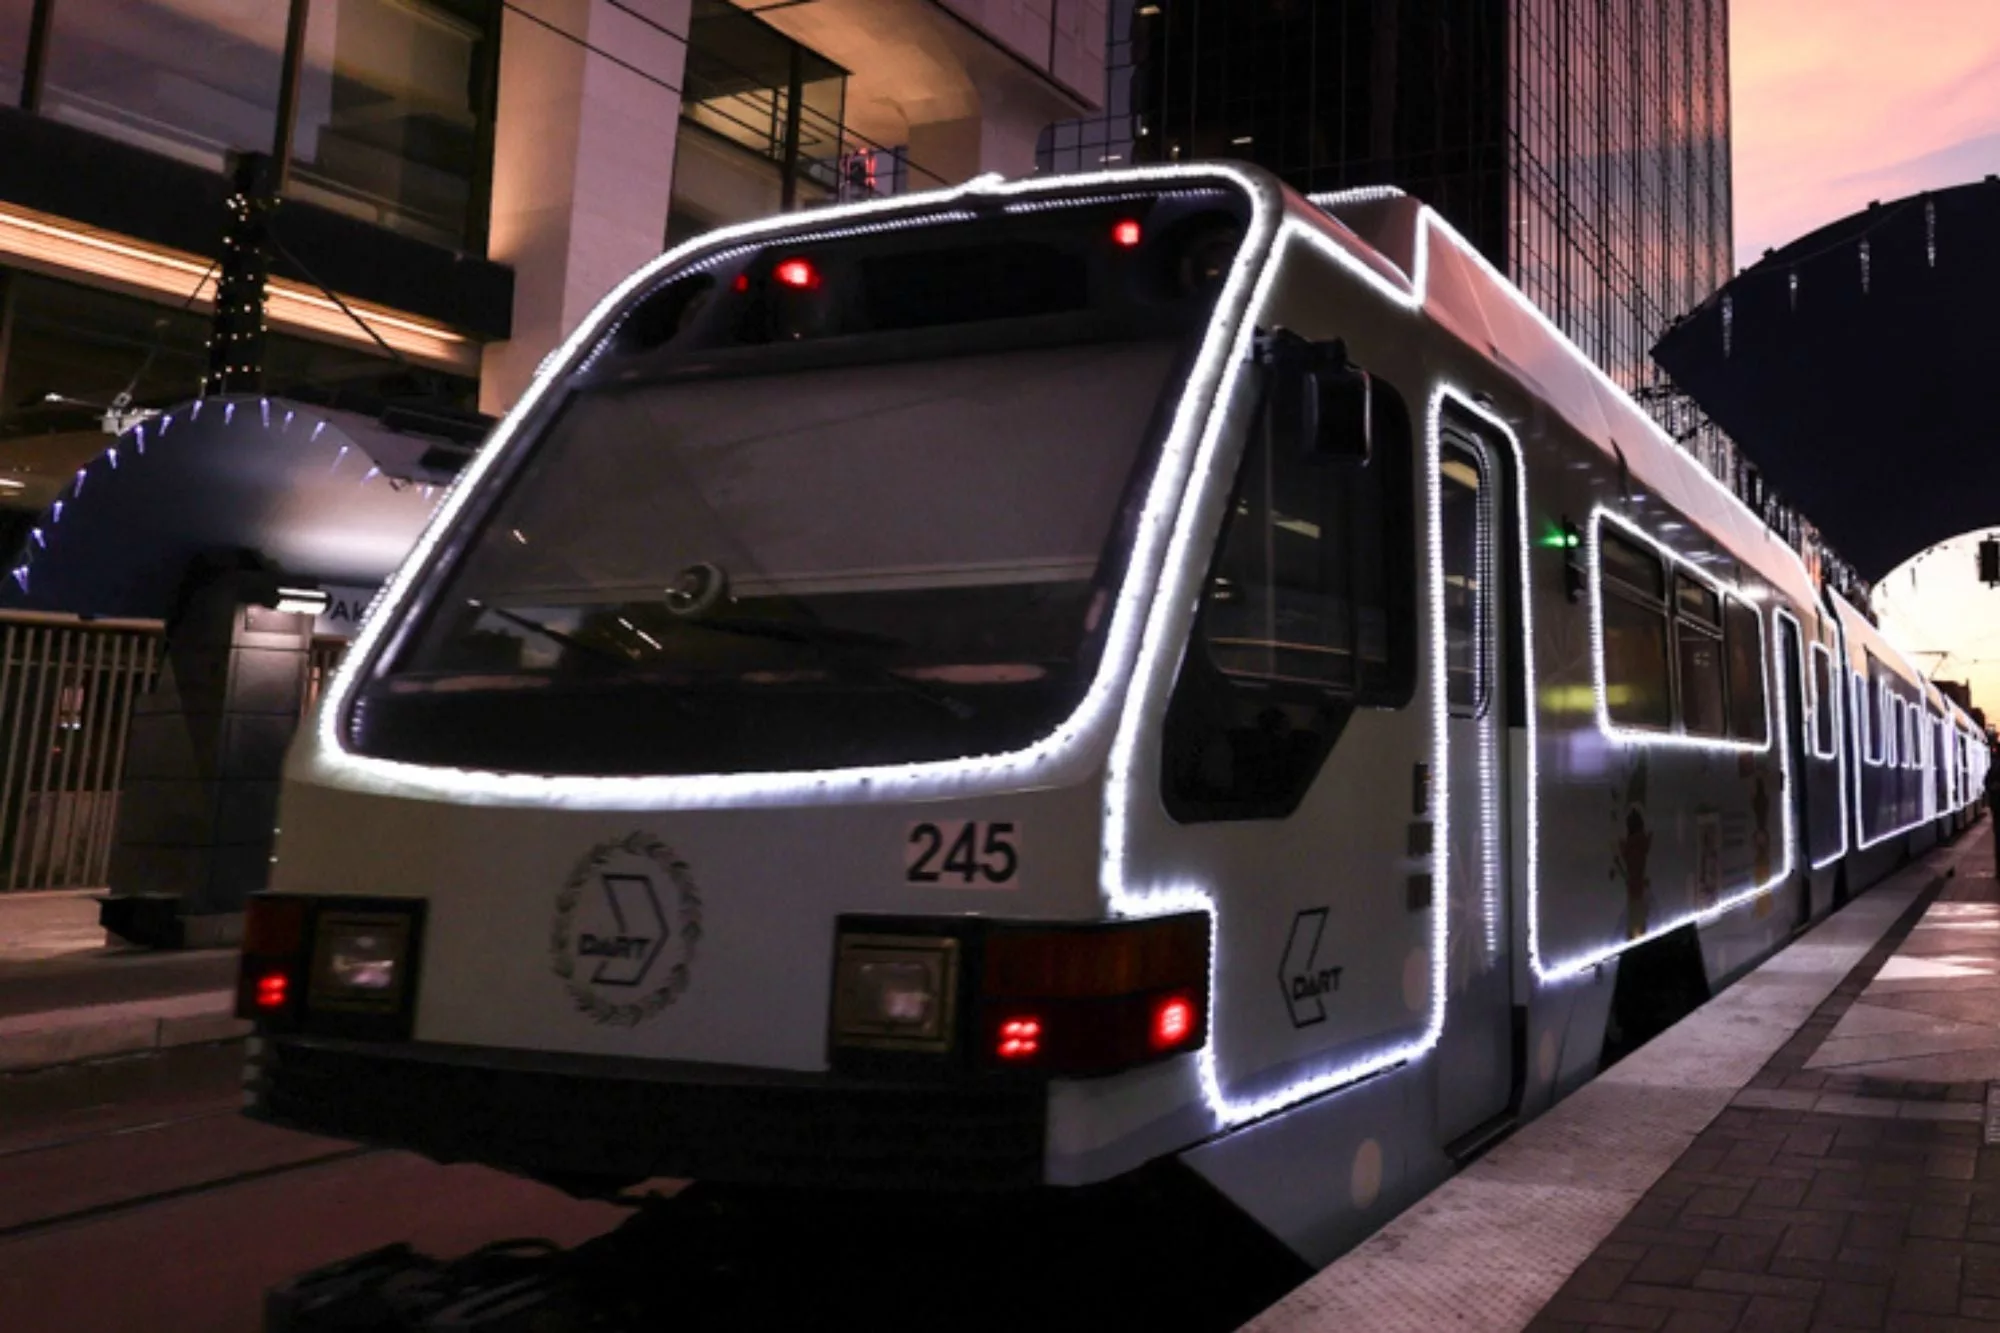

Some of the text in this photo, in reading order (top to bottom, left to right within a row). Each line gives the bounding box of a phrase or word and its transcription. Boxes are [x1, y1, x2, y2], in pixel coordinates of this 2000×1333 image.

[908, 821, 1018, 884] 245
[578, 933, 651, 960] DART
[1292, 965, 1344, 1001] DART
